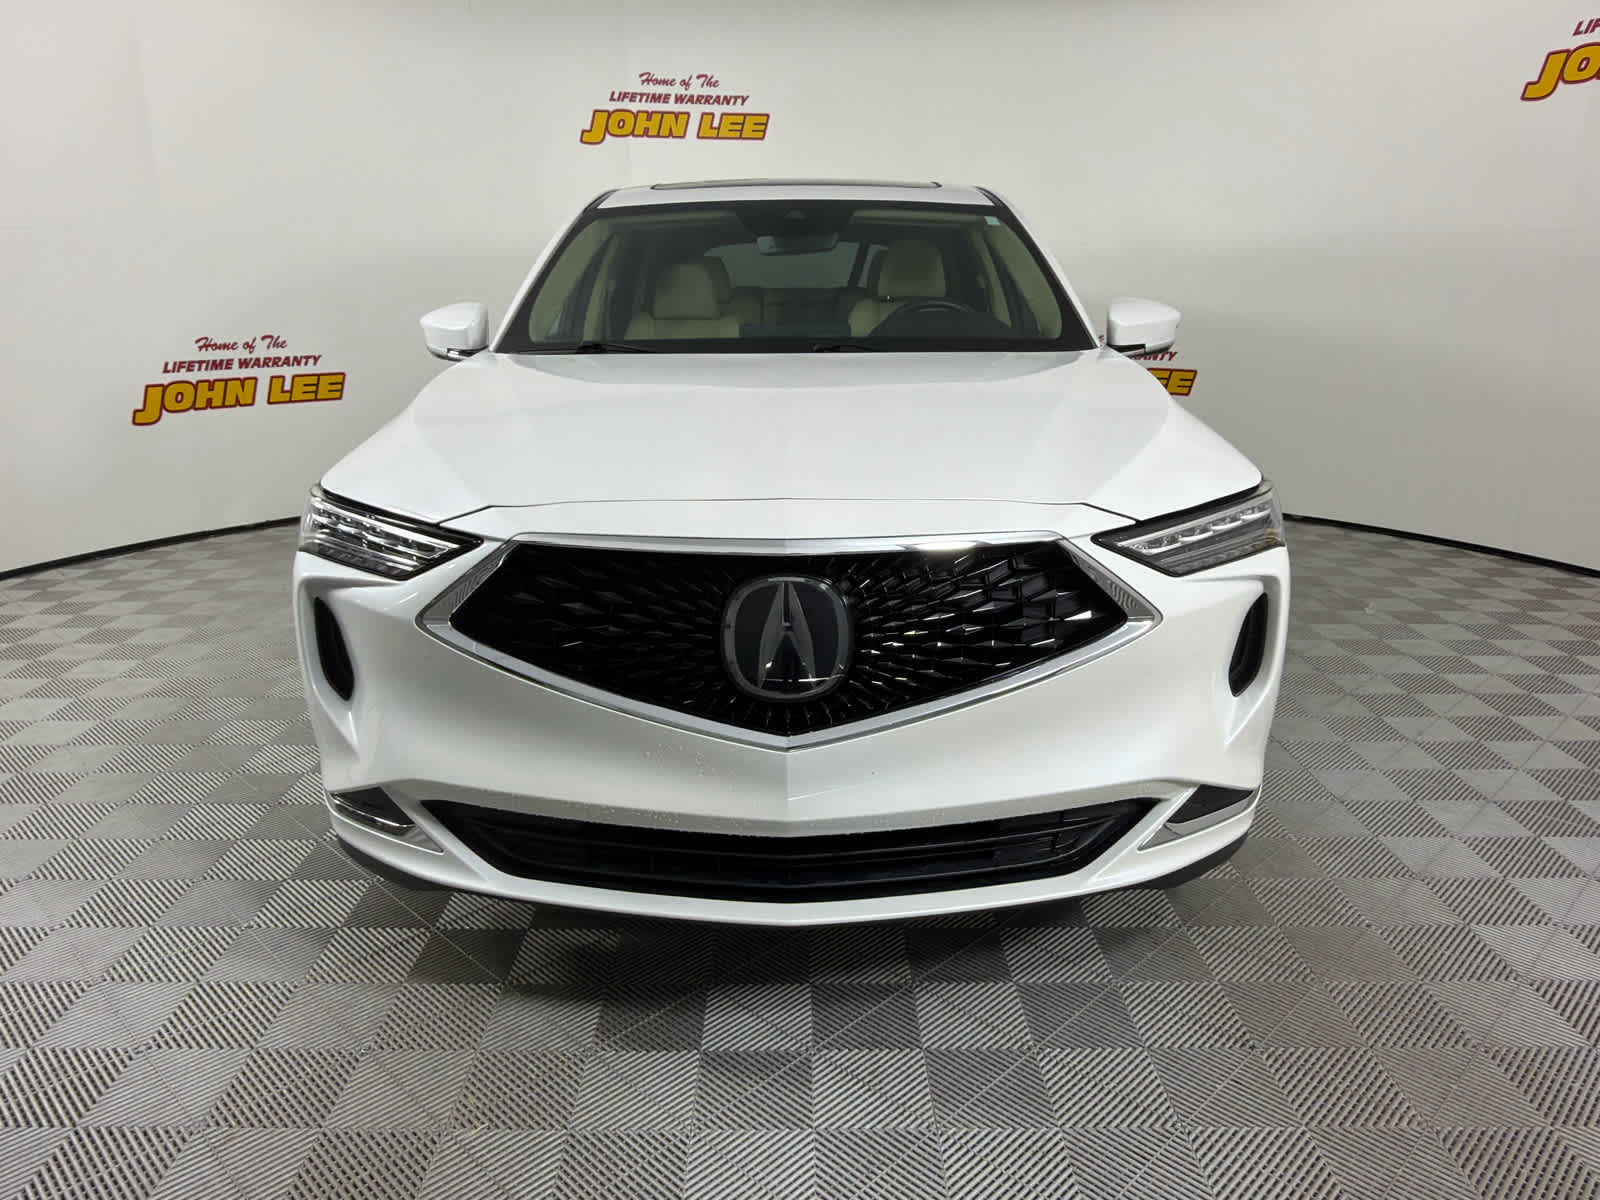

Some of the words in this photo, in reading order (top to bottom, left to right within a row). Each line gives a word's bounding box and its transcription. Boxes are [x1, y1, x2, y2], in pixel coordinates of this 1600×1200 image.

[639, 72, 677, 87] Home
[679, 73, 693, 91] of
[696, 74, 720, 88] The
[609, 91, 671, 104] LIFETIME
[674, 93, 749, 106] WARRANTY
[580, 109, 690, 145] JOHN
[696, 111, 770, 141] LEE
[195, 336, 238, 352] Home
[242, 337, 256, 354] of
[261, 334, 287, 349] The
[163, 358, 234, 374] LIFETIME
[237, 354, 322, 369] WARRANTY
[132, 376, 258, 426] JOHN
[267, 371, 346, 405] LEE
